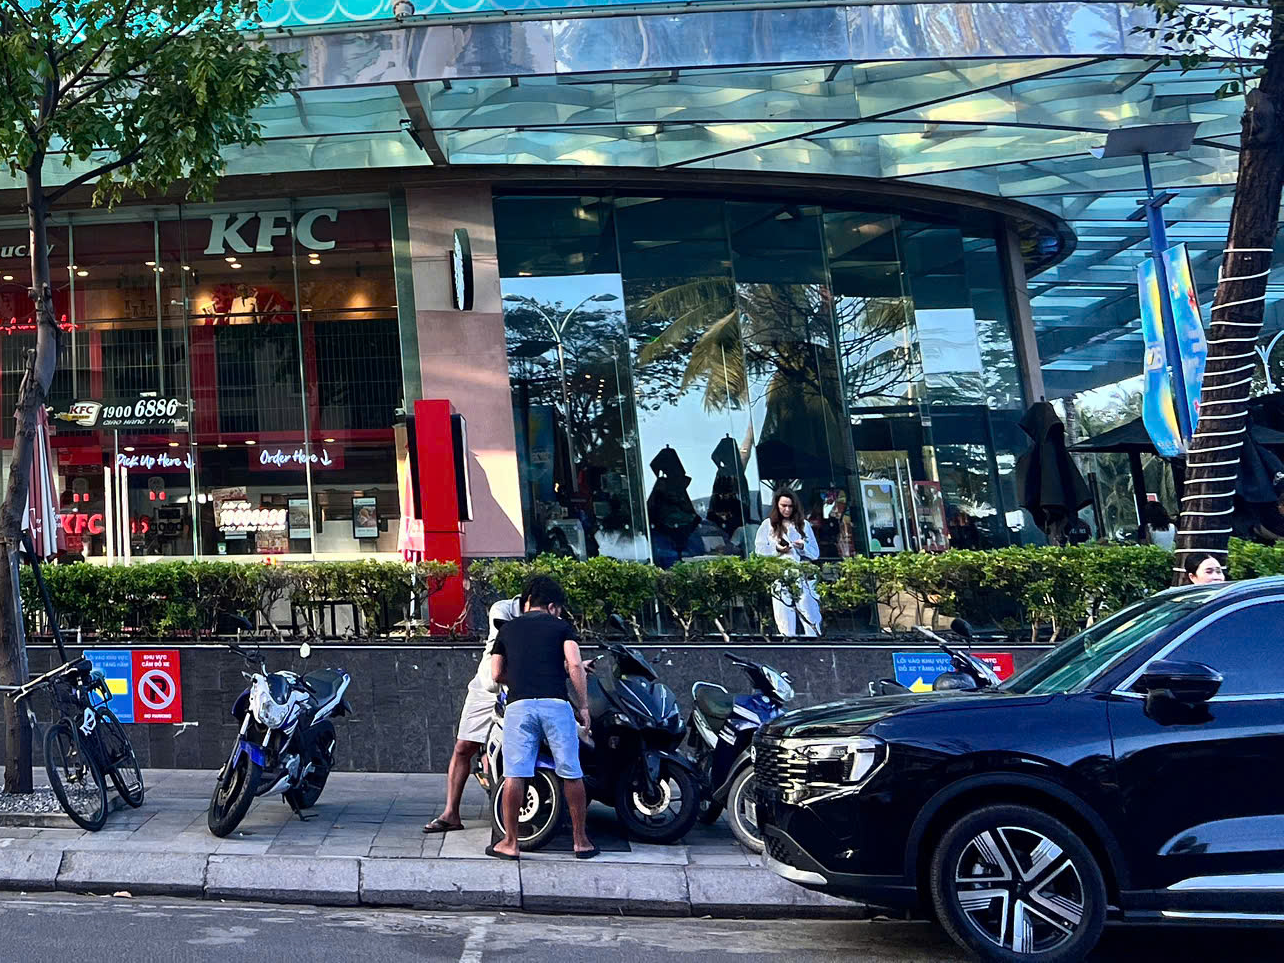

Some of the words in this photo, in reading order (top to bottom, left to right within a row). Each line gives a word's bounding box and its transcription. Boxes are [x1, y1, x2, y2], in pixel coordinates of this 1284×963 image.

[204, 209, 337, 255] KFC
[70, 405, 94, 415] KFC
[102, 406, 132, 418] 1900
[134, 399, 178, 418] 6886
[116, 453, 139, 468] Pick
[140, 455, 156, 470] Up
[157, 452, 182, 467] Here
[260, 449, 293, 467] Order
[293, 448, 318, 465] Here
[59, 513, 104, 534] KFC
